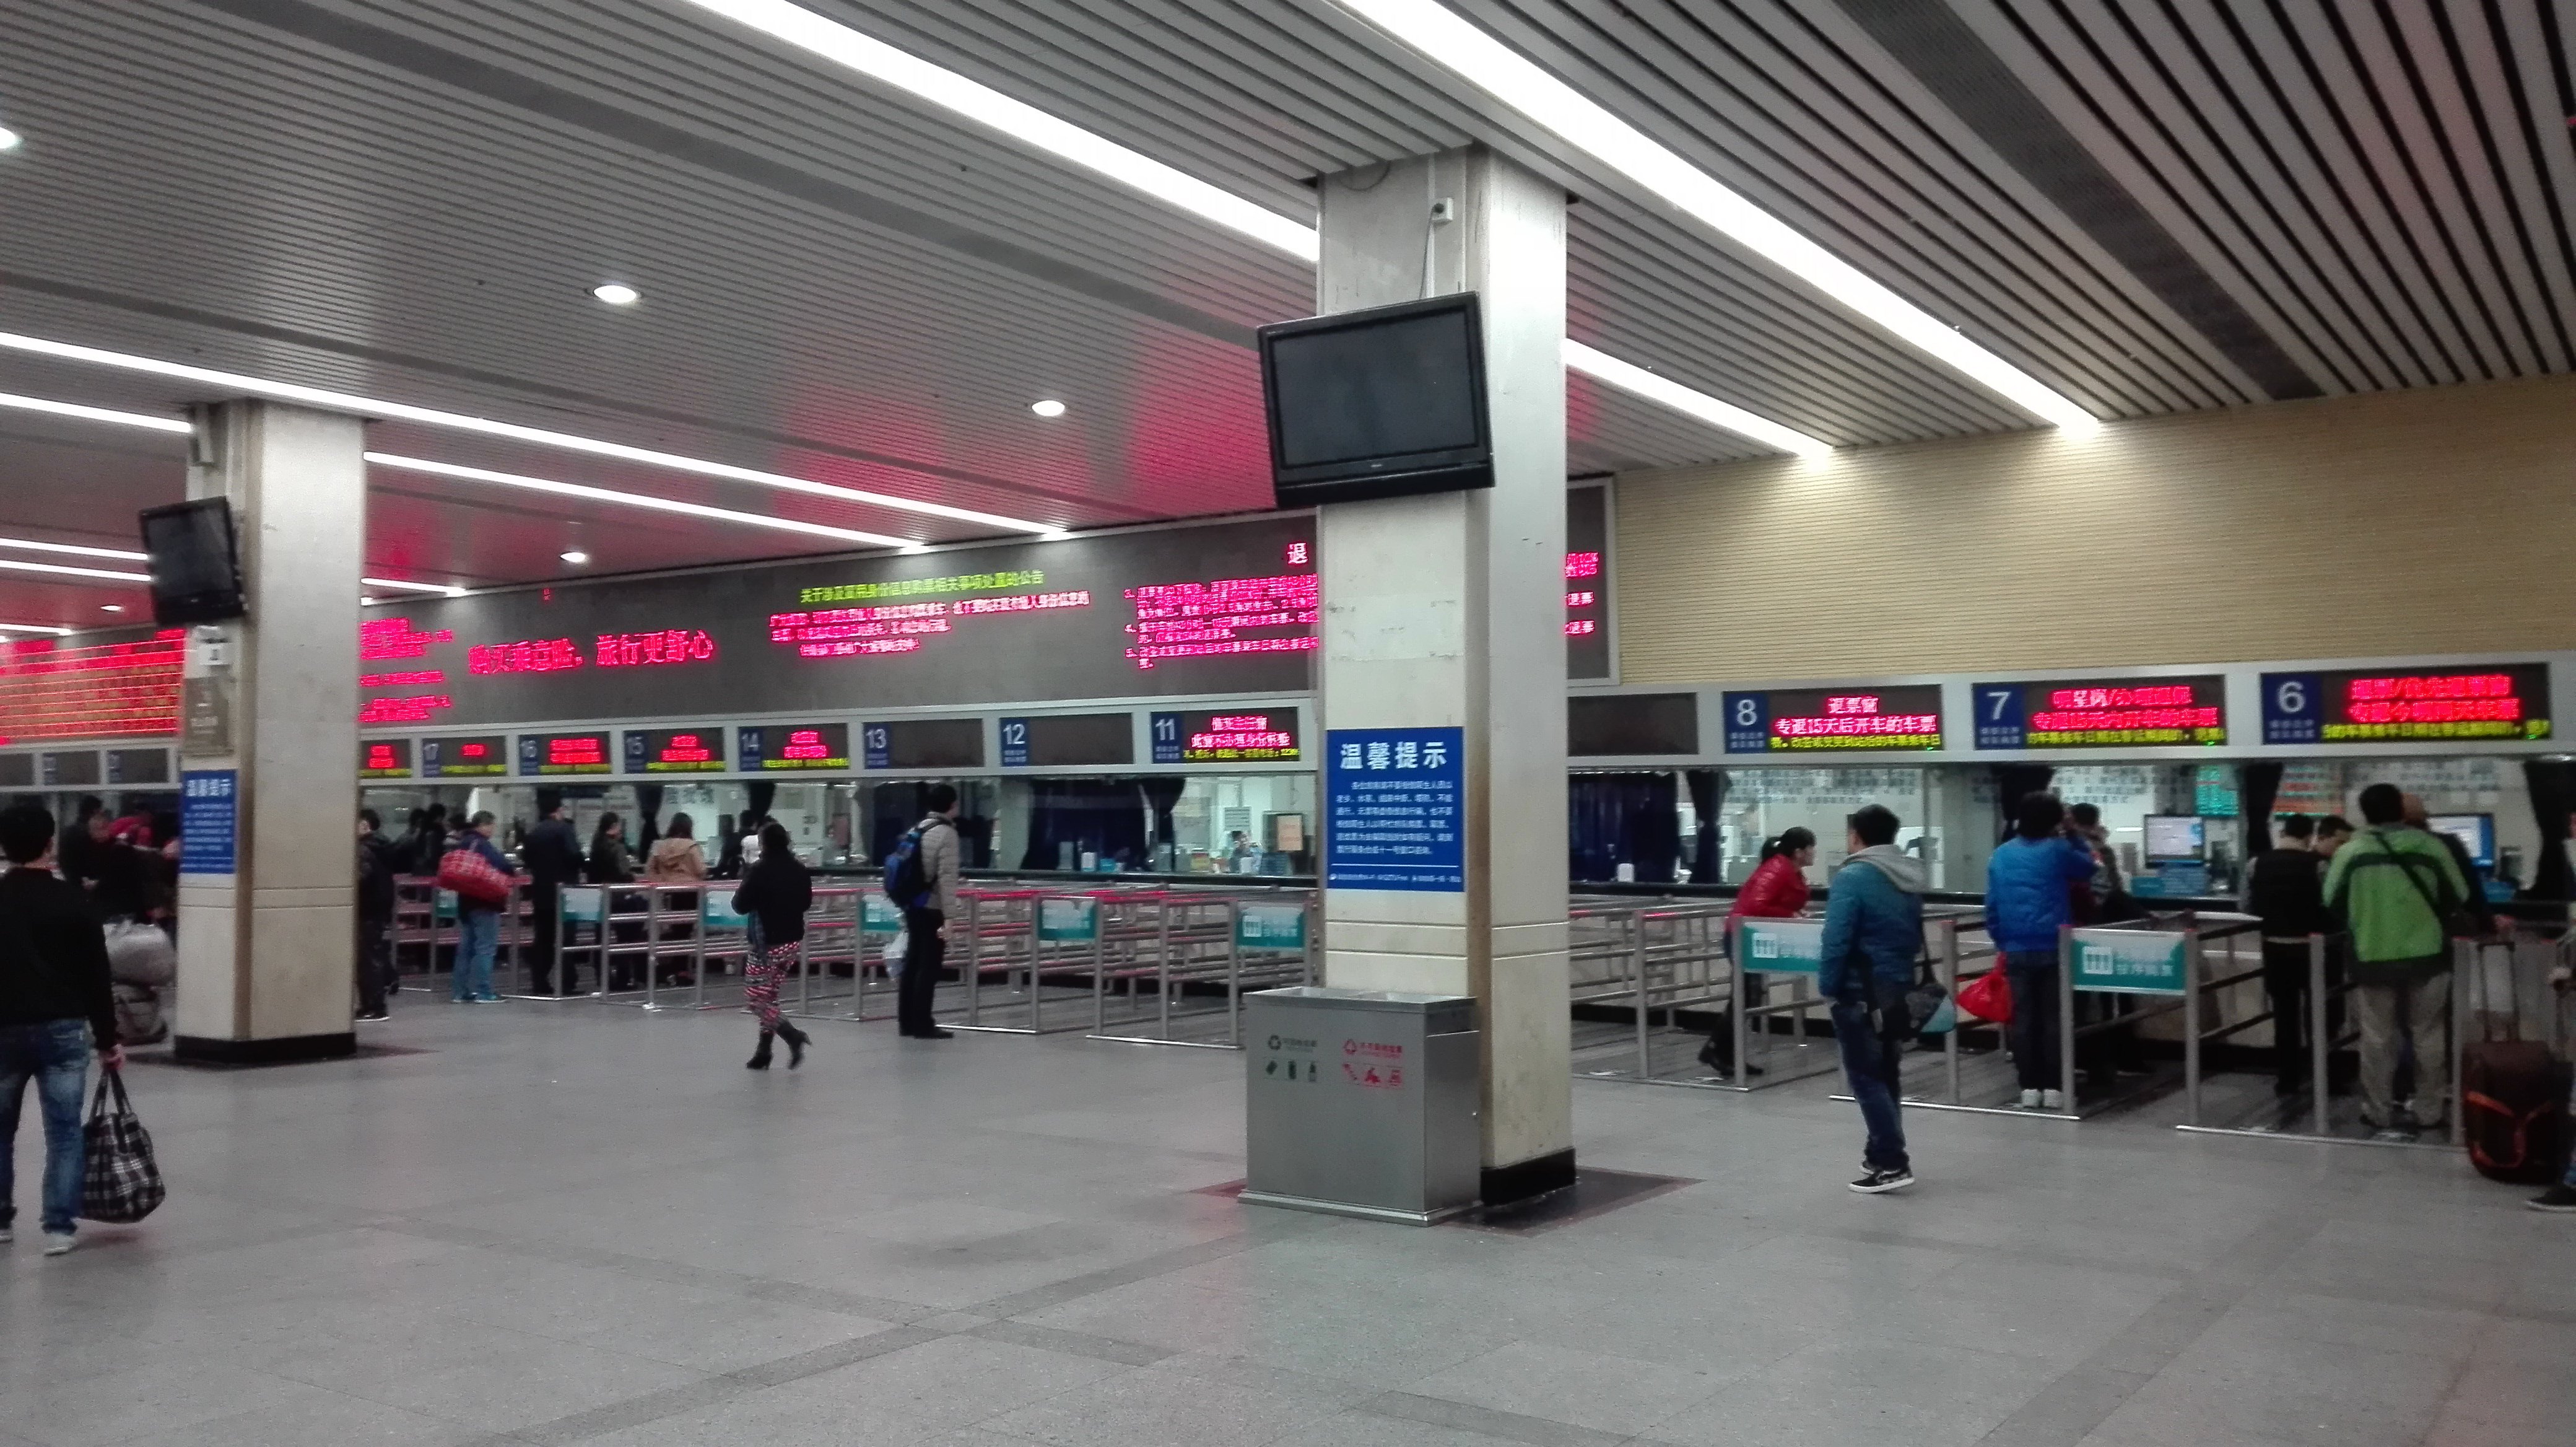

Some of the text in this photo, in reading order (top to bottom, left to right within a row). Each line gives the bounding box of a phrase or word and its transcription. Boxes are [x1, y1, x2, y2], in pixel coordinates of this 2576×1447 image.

[1827, 696, 1879, 714] 退票窗
[1986, 691, 2011, 720] 7
[2277, 681, 2306, 714] 6
[1736, 699, 1757, 726] 8
[1003, 724, 1025, 745] 12
[1155, 718, 1176, 741] 11
[1775, 714, 1938, 735] 专退15天后开车的车票
[742, 732, 759, 752] 14
[866, 728, 887, 749] 13
[1339, 741, 1448, 770] 温馨提示
